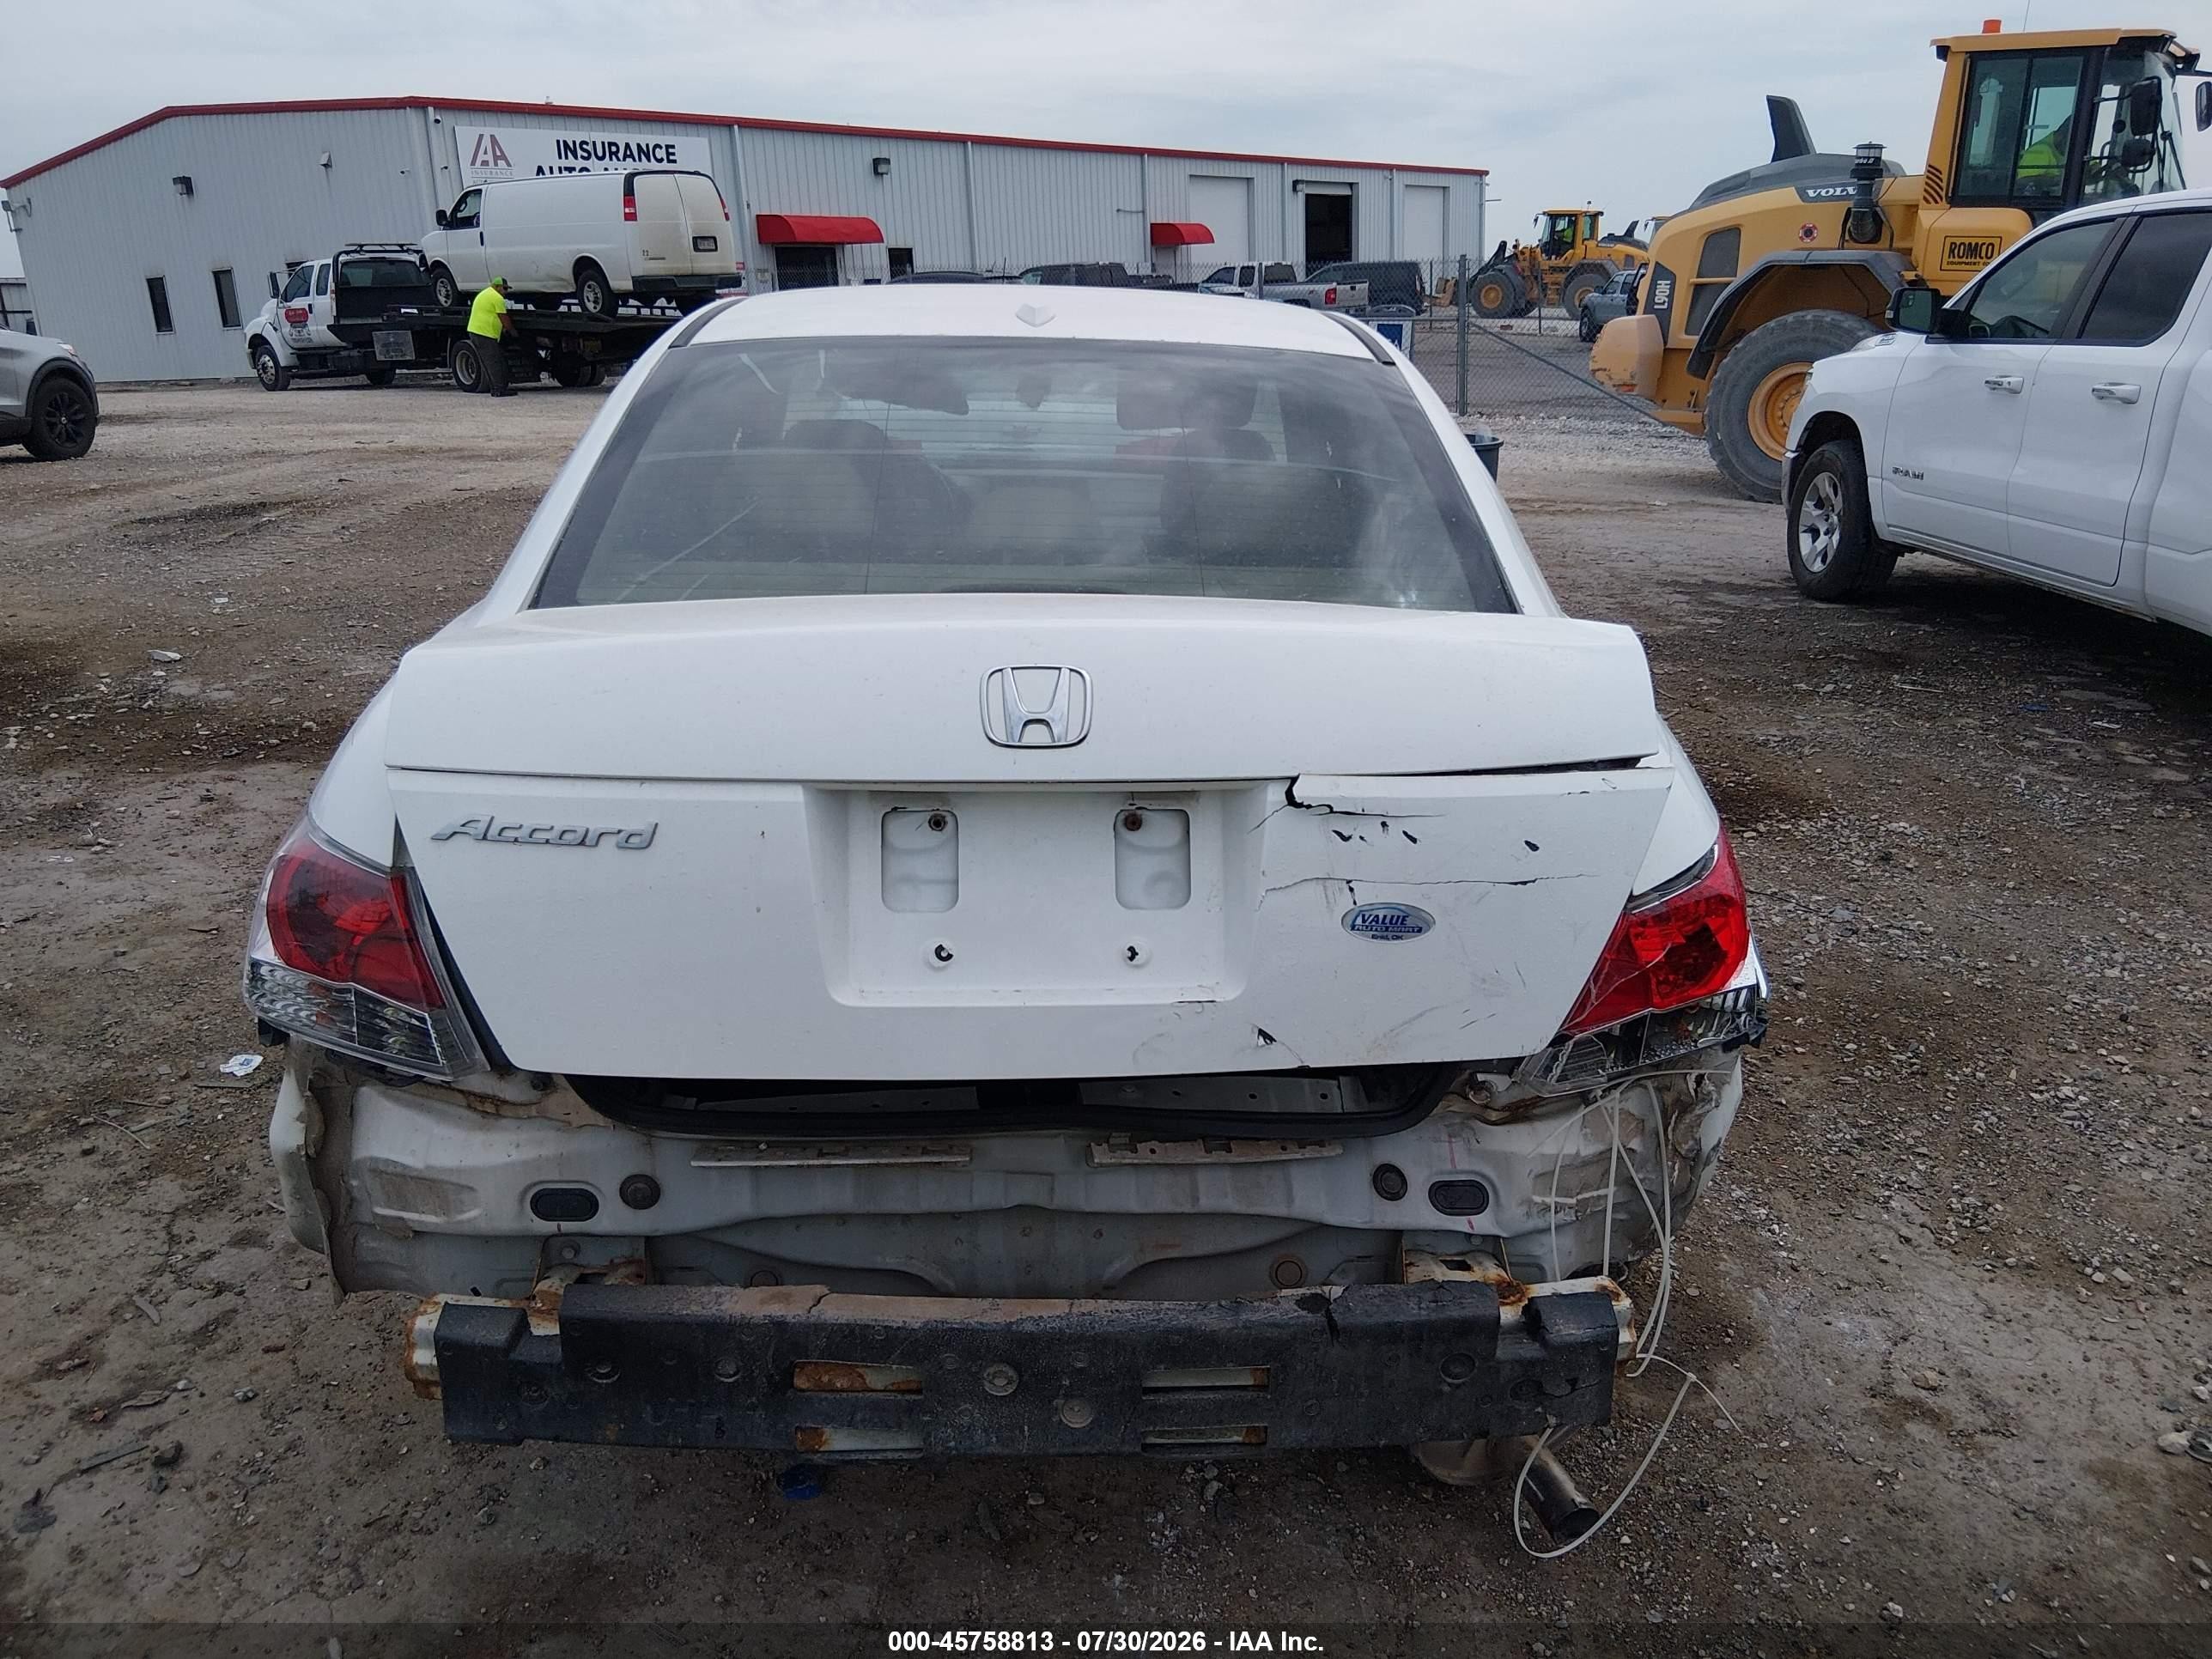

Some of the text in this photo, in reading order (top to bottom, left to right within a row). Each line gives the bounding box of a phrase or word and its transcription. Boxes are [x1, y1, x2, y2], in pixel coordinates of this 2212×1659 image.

[556, 139, 677, 164] INSURANCE
[536, 165, 592, 177] AT
[1805, 186, 1858, 198] VOLV
[1948, 241, 1995, 260] ROMCO
[1654, 280, 1671, 309] L90H
[1892, 466, 1924, 481] RAM
[430, 814, 659, 848] Accord
[1361, 913, 1410, 926] VALUE
